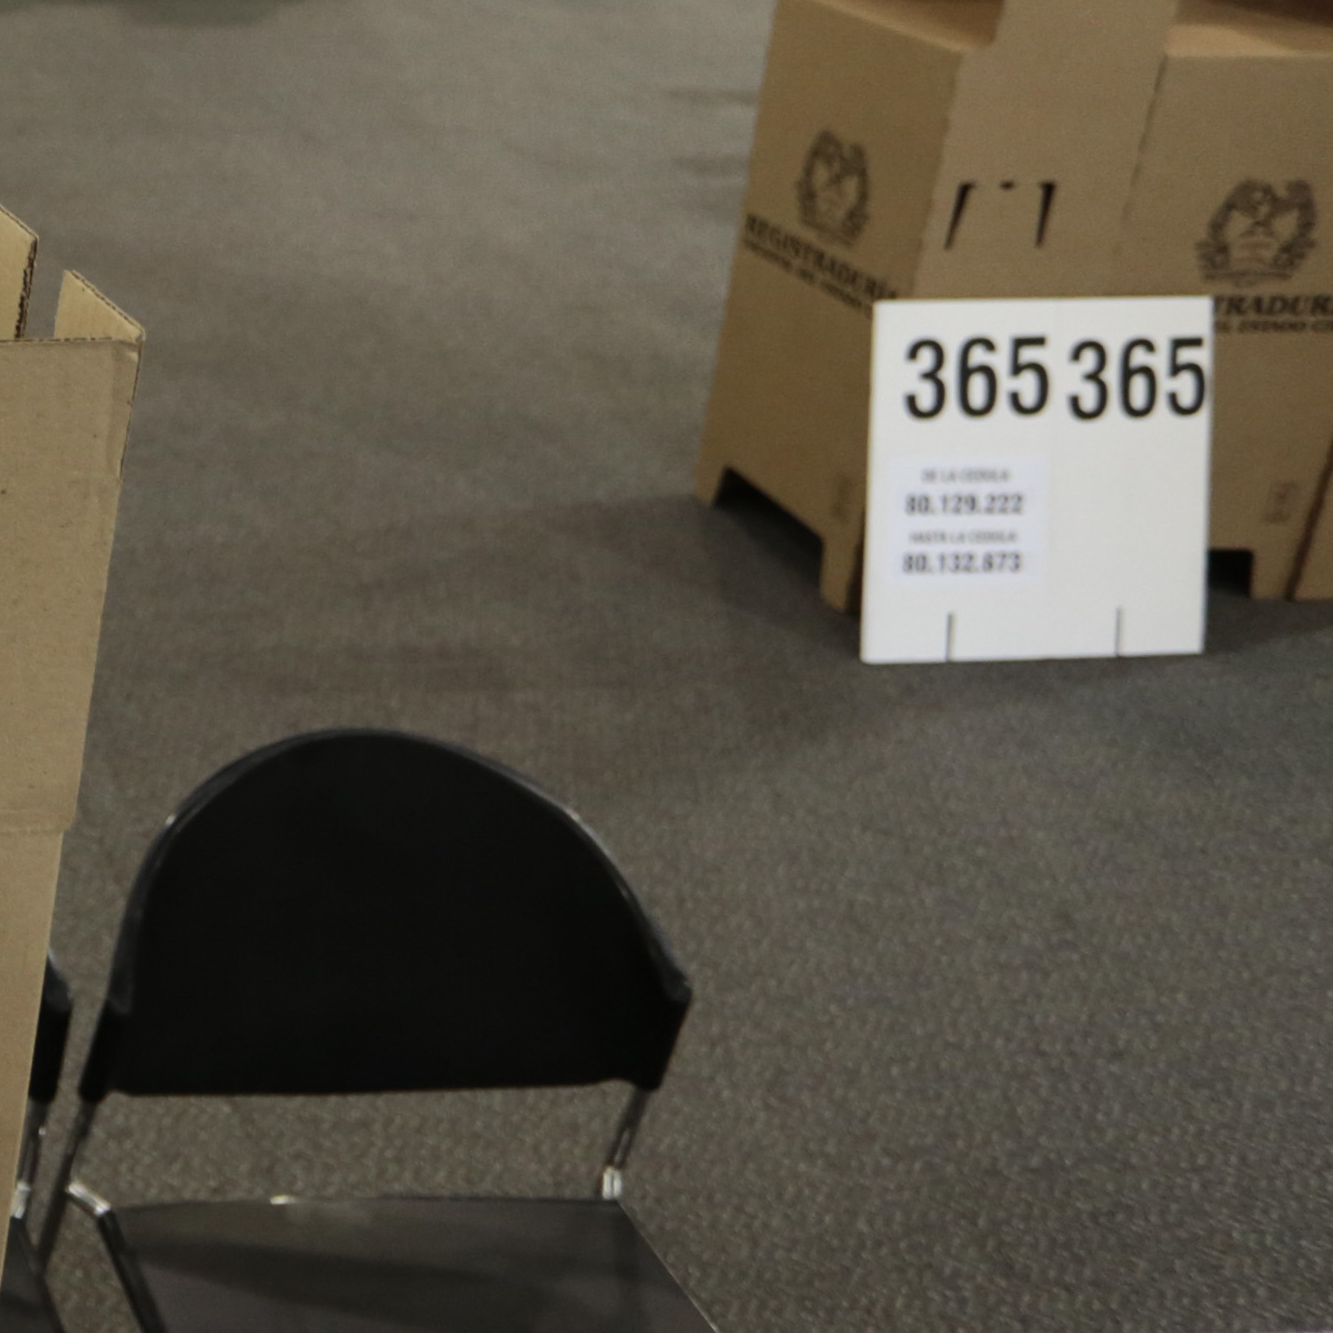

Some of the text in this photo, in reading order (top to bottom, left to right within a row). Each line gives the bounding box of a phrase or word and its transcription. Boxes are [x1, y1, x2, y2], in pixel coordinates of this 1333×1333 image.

[904, 336, 1207, 420] 365 365
[906, 493, 1024, 515] 80.129.222
